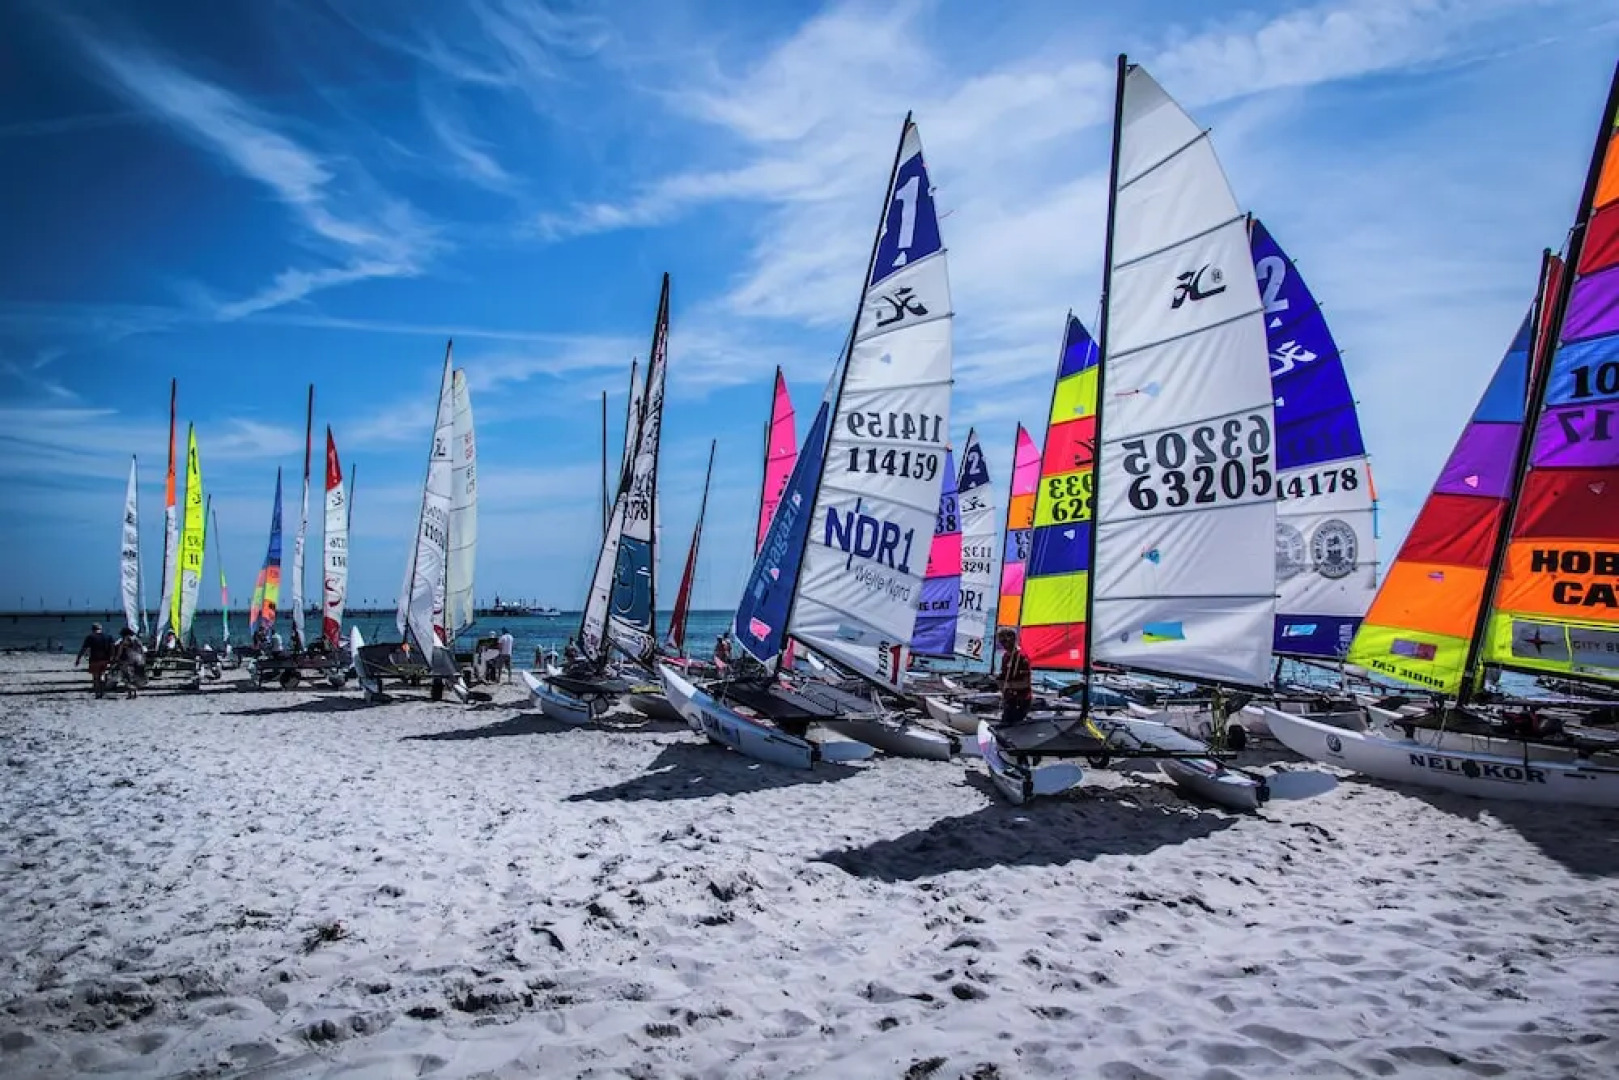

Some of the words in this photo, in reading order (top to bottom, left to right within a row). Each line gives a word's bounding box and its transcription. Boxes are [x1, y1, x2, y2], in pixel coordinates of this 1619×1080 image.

[895, 176, 921, 249] 1
[1256, 255, 1290, 314] 2
[846, 446, 938, 481] 114159
[1128, 454, 1272, 511] 63205
[824, 503, 915, 574] NDR1
[1553, 581, 1619, 607] CA
